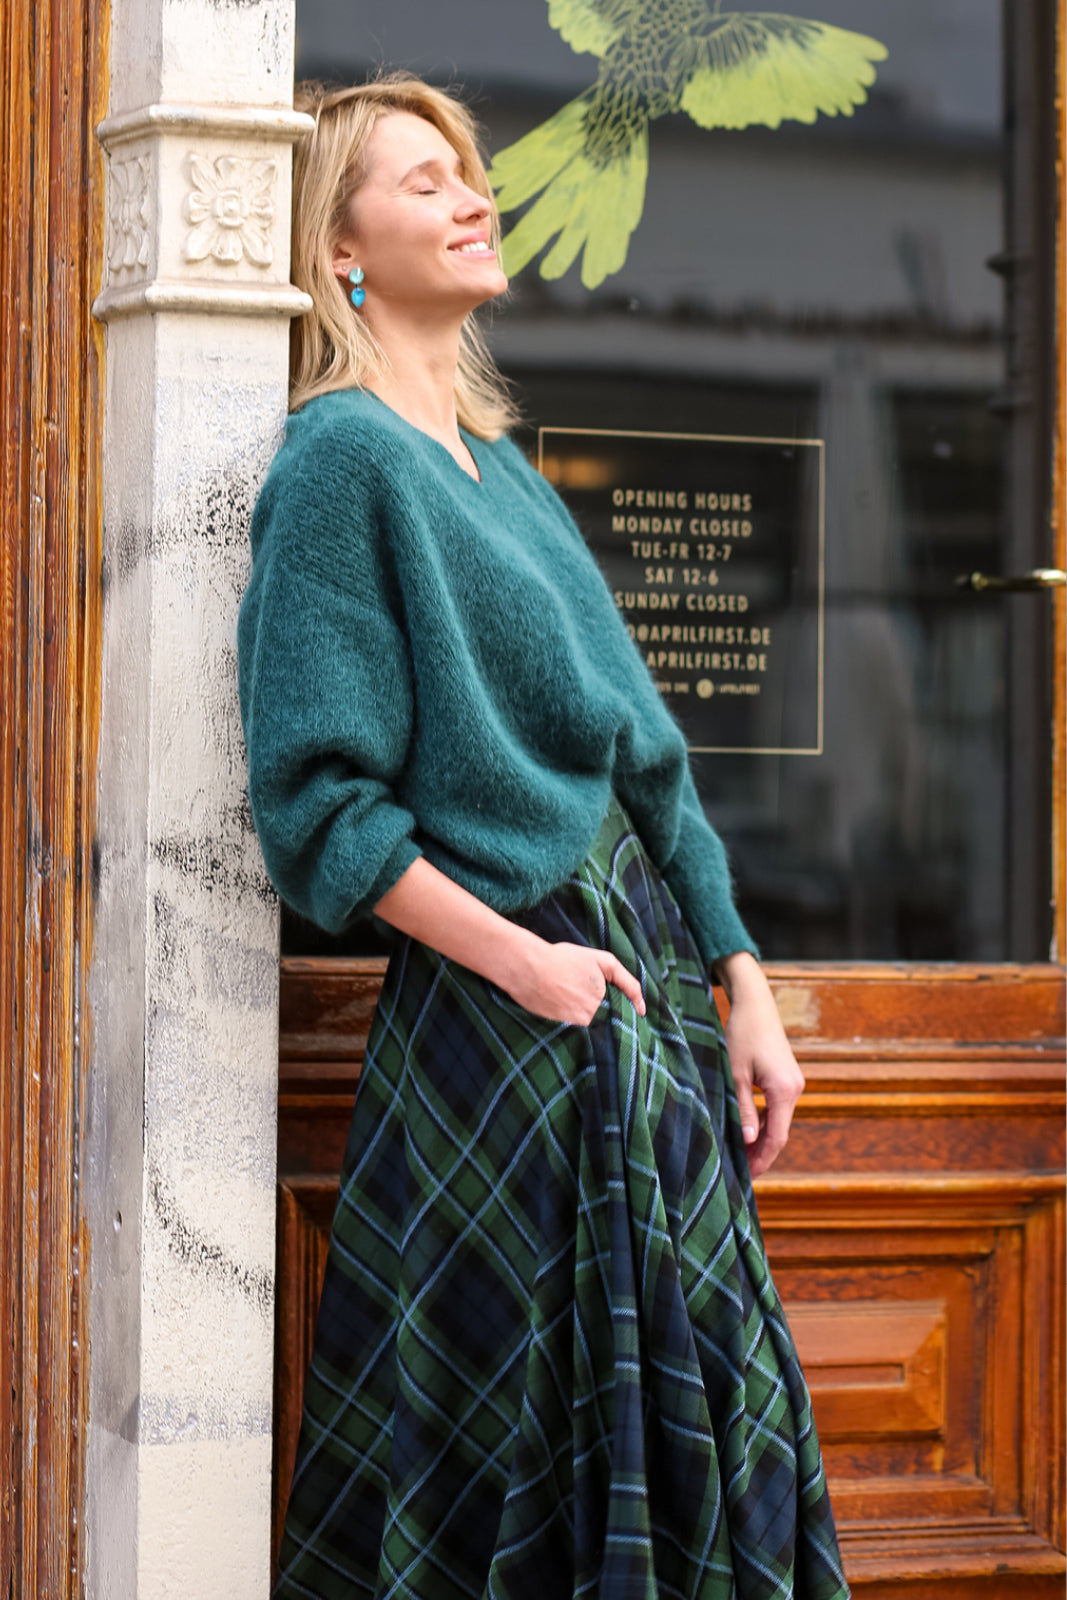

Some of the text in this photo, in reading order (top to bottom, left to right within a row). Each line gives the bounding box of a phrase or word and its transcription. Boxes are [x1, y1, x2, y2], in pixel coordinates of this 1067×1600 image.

[612, 489, 752, 512] OPENING HOURS
[612, 515, 752, 537] MONDAY CLOSED
[645, 566, 674, 584] SAT
[614, 591, 749, 613] SUNDAY CLOSED
[627, 624, 771, 645] O@APRILFIRST.DE
